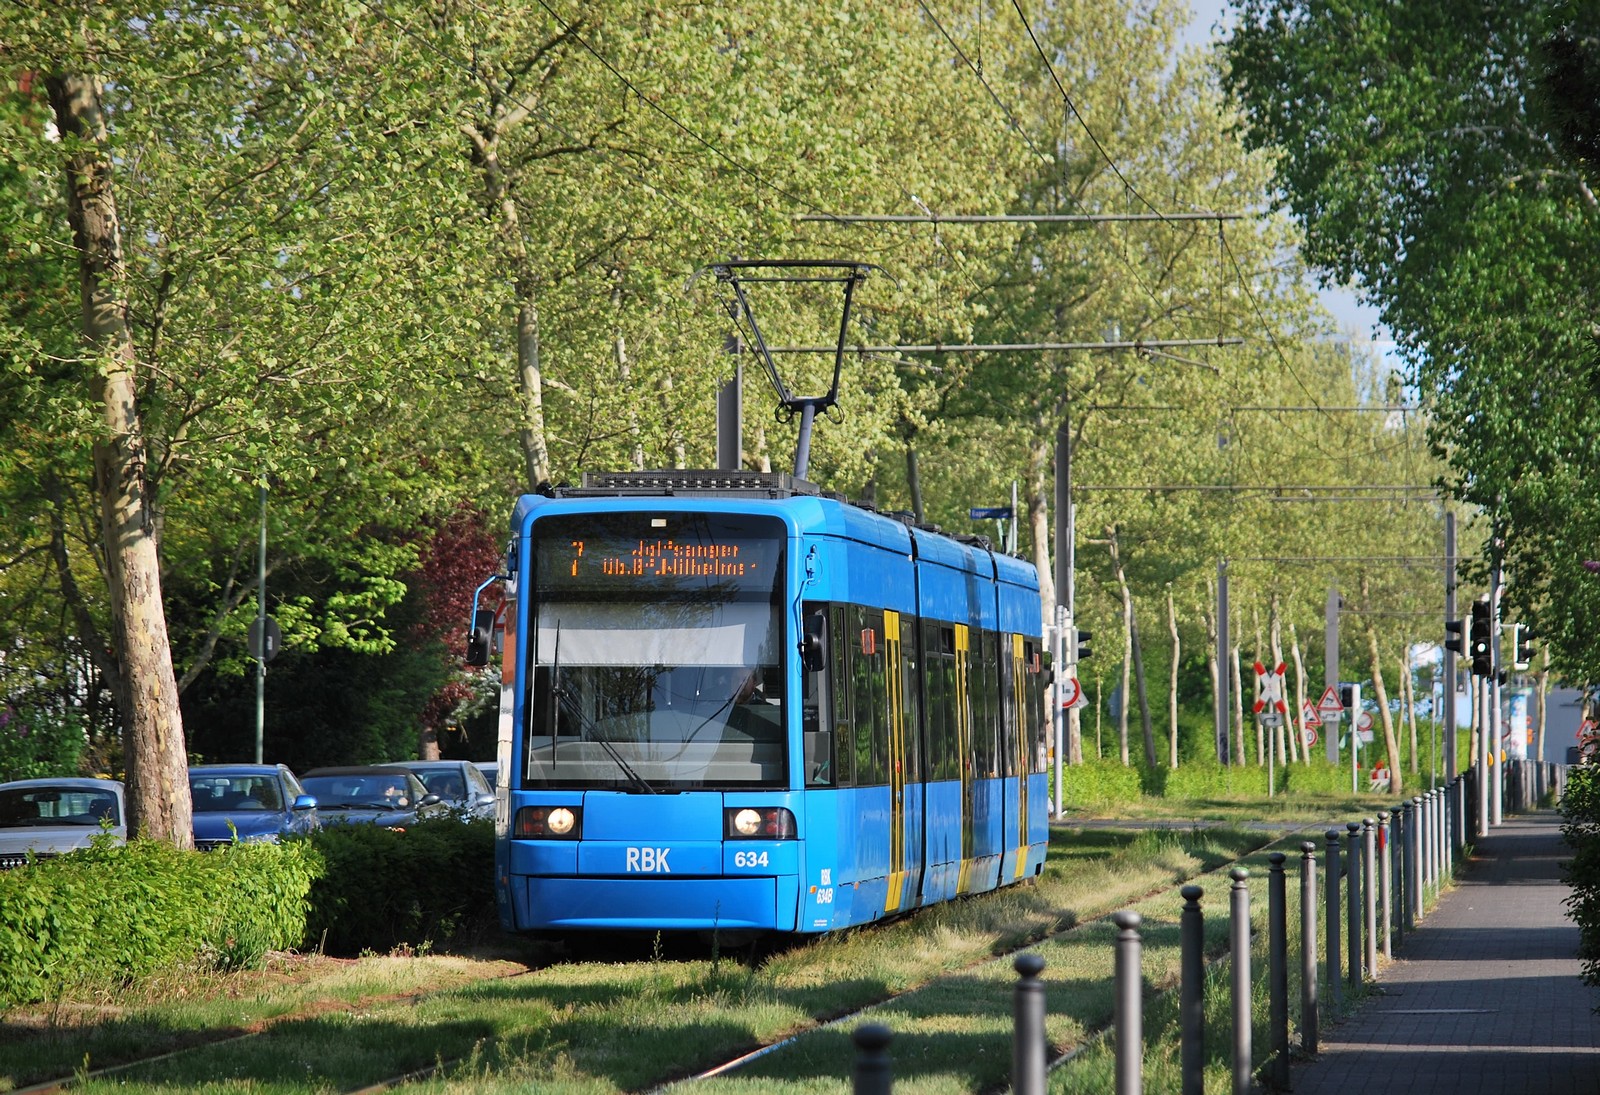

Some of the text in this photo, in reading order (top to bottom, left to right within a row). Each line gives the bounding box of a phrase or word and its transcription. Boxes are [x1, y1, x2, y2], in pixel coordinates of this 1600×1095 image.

[626, 847, 671, 872] RBK
[734, 851, 769, 867] 634
[820, 868, 832, 886] RBK
